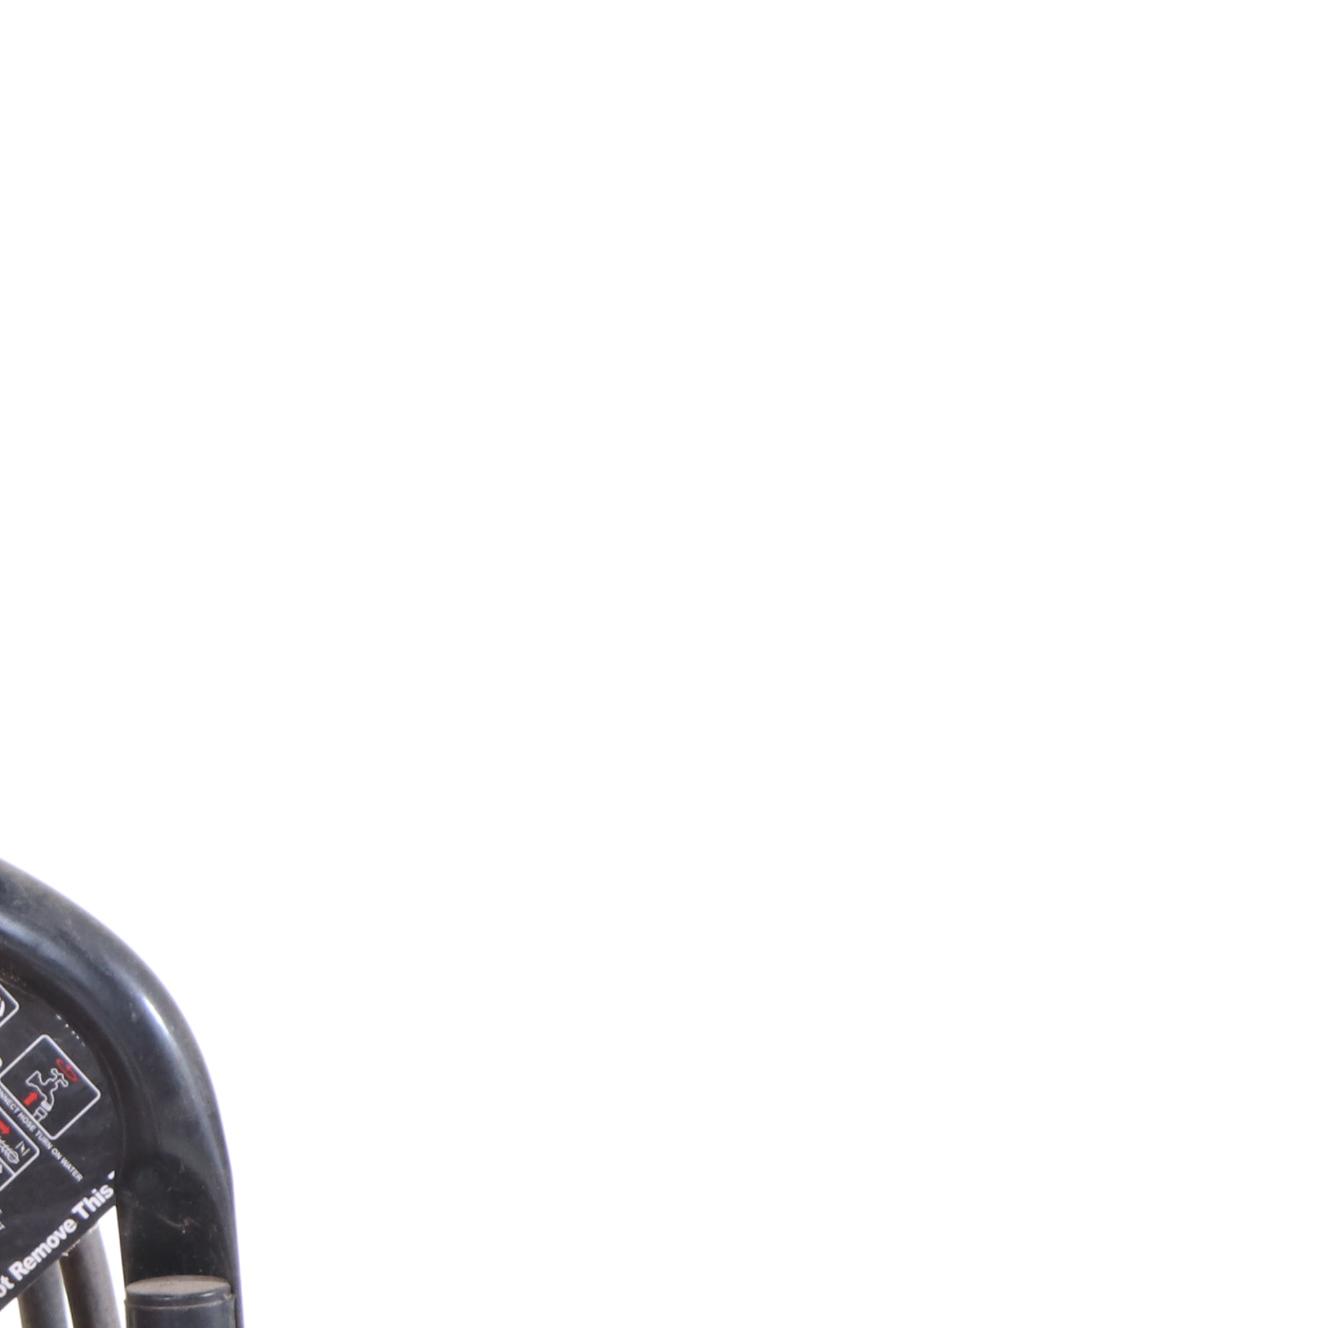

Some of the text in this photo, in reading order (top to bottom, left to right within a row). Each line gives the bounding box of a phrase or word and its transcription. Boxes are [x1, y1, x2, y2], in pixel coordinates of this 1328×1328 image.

[17, 1112, 36, 1131] HOSE
[35, 1129, 52, 1149] TURN
[51, 1147, 62, 1160] ON
[60, 1157, 82, 1181] WATER
[7, 1218, 77, 1281] Remove
[70, 1184, 114, 1219] This
